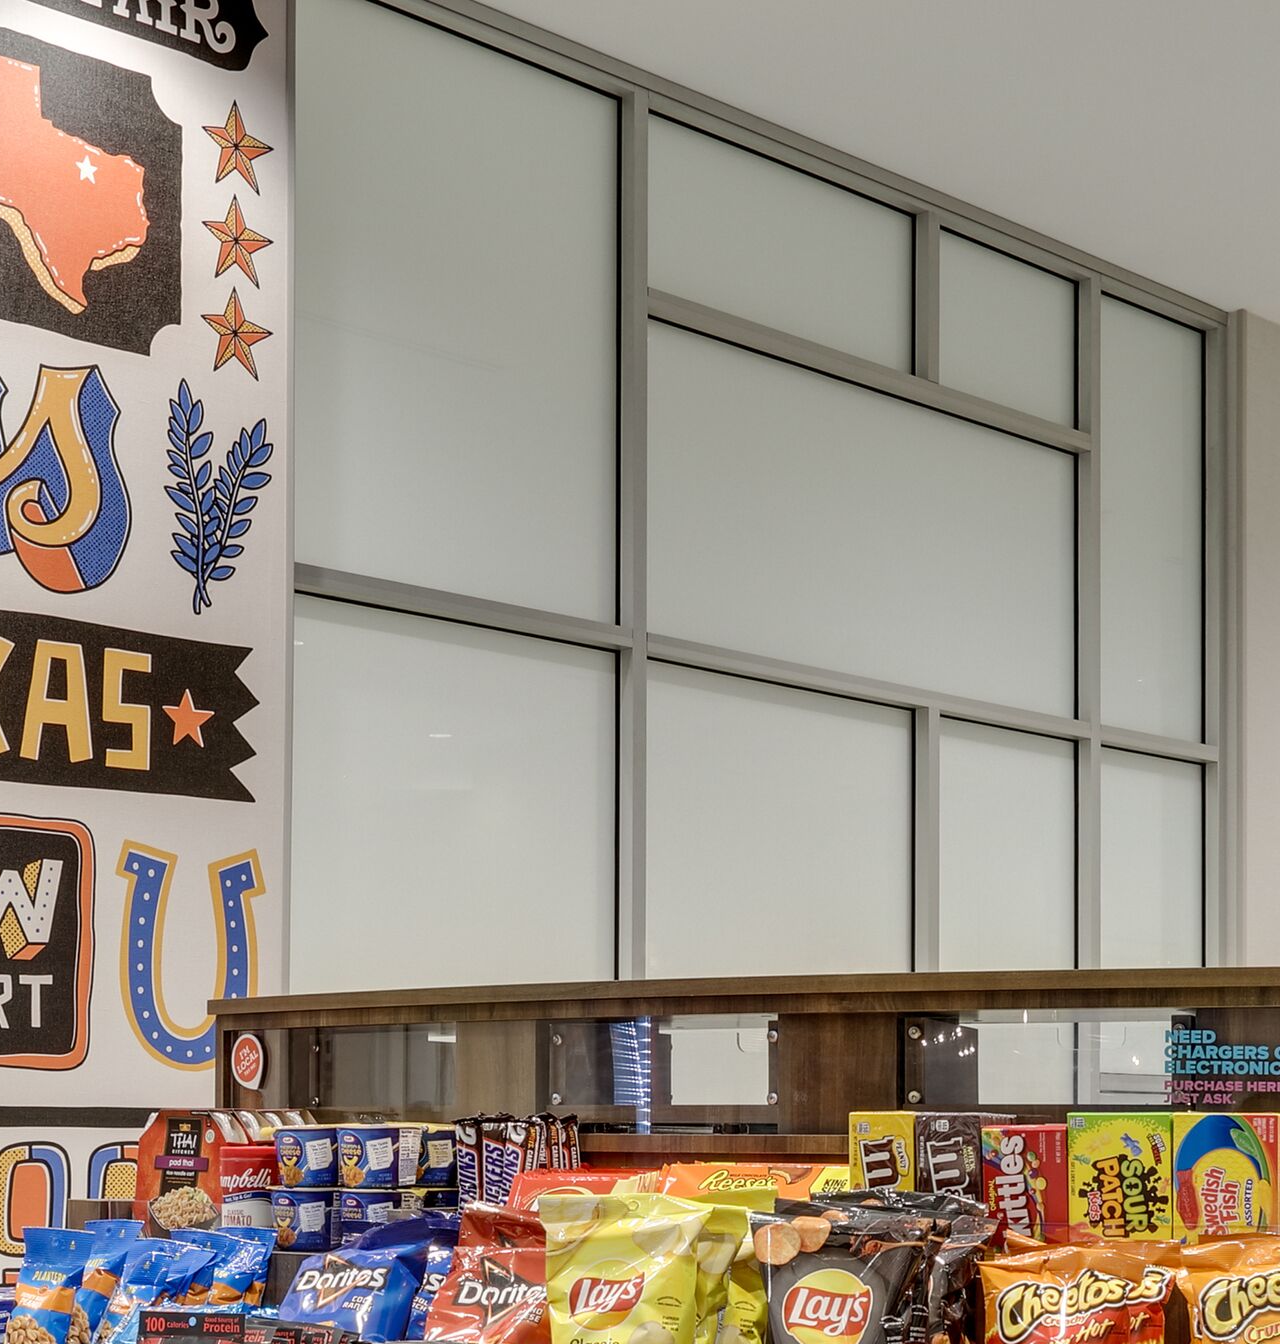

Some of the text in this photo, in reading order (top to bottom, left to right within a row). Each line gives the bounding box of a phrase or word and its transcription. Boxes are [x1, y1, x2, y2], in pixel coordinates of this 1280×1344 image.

[1165, 1030, 1216, 1044] NEED
[236, 1050, 259, 1074] LOCAL
[1165, 1045, 1269, 1060] CHARGERS
[1165, 1081, 1243, 1092] PURCHASE
[1165, 1093, 1236, 1104] JUST ASK.
[170, 1133, 197, 1149] THAI
[169, 1159, 195, 1167] pad thai
[895, 1141, 908, 1169] PEANUT
[220, 1167, 272, 1193] mpbell's
[699, 1169, 778, 1191] Reese's
[824, 1179, 848, 1187] KING
[1088, 1191, 1100, 1221] Kids
[1096, 1156, 1126, 1238] PATCH
[1121, 1159, 1149, 1233] SOUR
[1201, 1166, 1225, 1235] Swedish
[1219, 1181, 1240, 1226] Fish
[1242, 1179, 1253, 1226] ASSORTED
[296, 1267, 389, 1291] Doritos
[574, 1275, 644, 1316] Lay's
[1000, 1270, 1125, 1339] Cheetos
[145, 1316, 189, 1332] 100 Calories
[788, 1288, 869, 1336] Lay's
[203, 1322, 240, 1333] Protein
[1075, 1318, 1115, 1344] Hot
